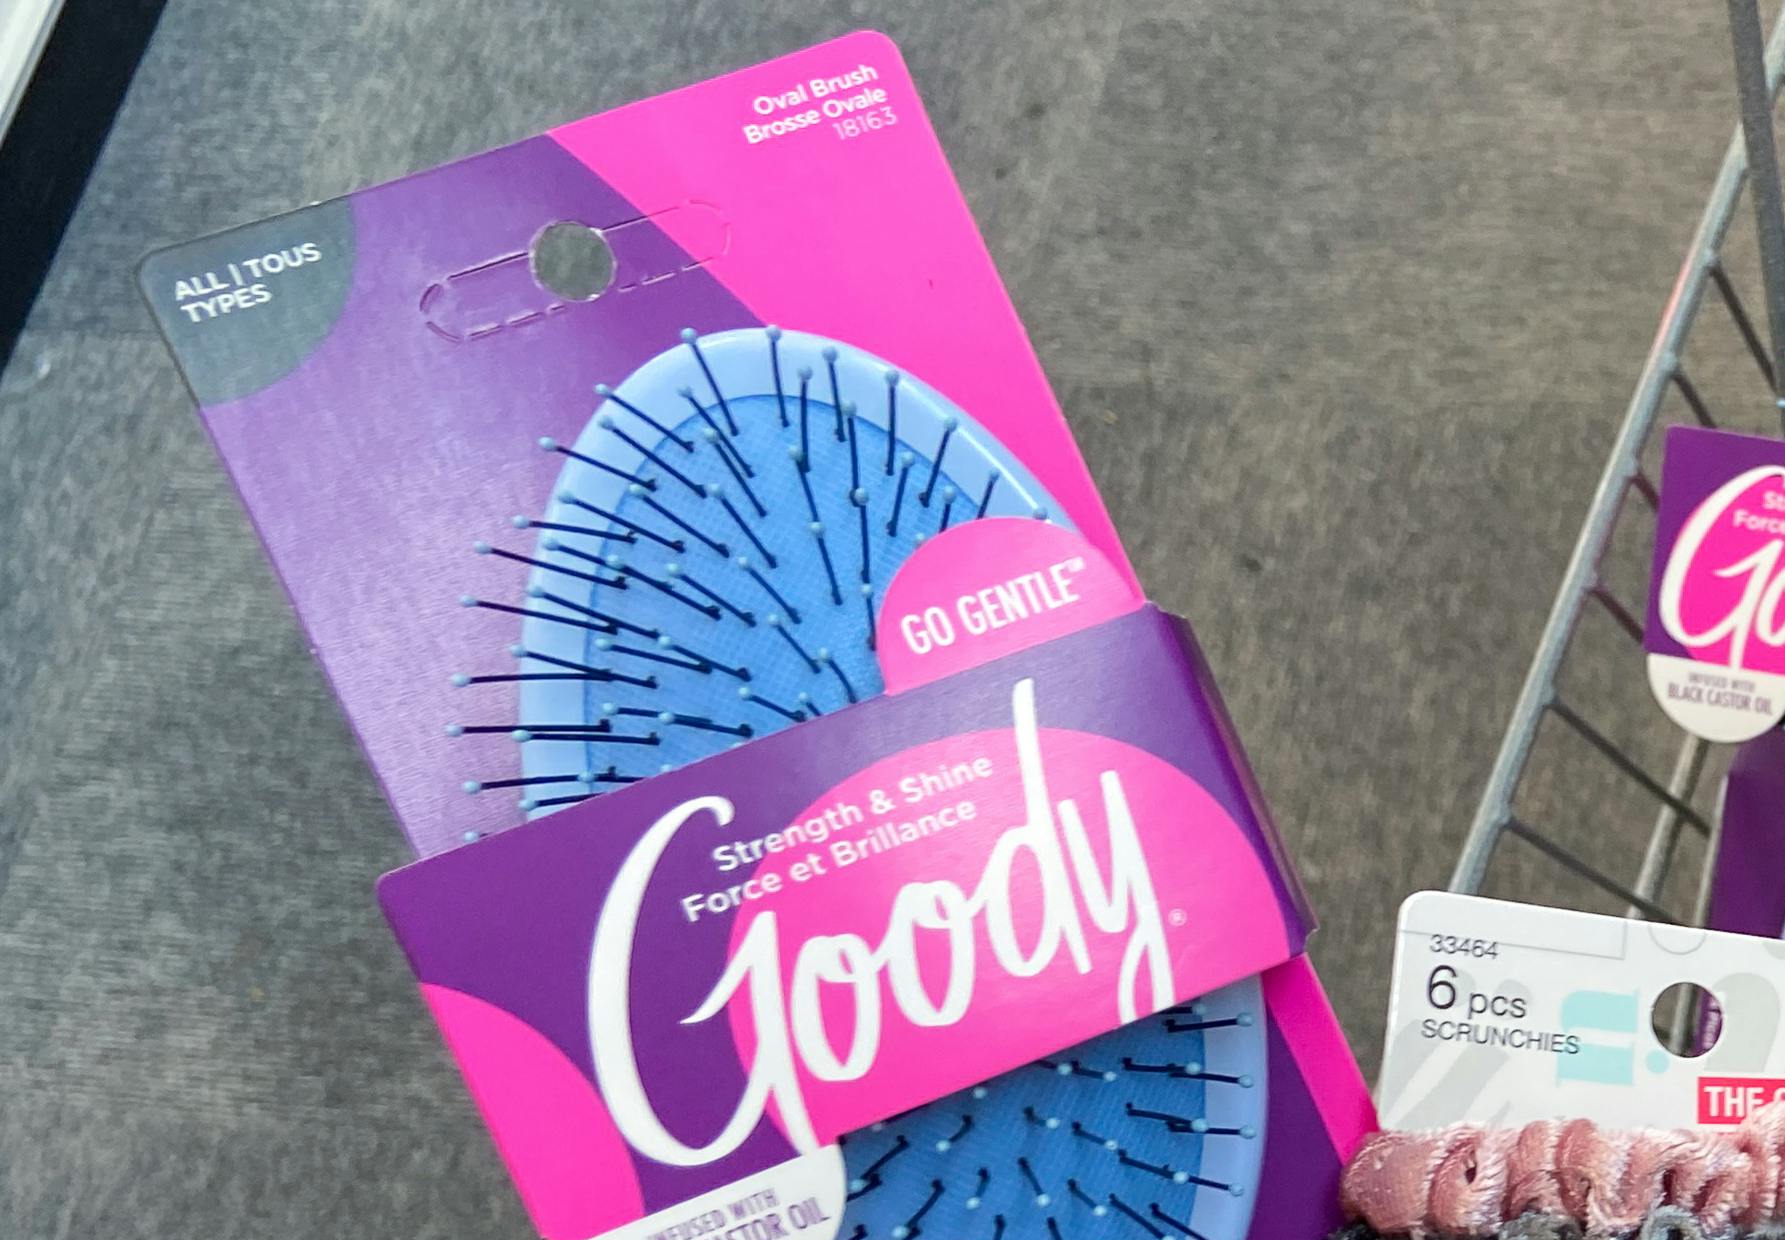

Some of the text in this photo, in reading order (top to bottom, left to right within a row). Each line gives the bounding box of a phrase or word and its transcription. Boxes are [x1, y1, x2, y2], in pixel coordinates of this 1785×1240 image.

[742, 88, 888, 144] Brosse Ovale
[753, 64, 879, 115] Oval Brush
[832, 106, 897, 140] 18163
[175, 271, 230, 301] ALL
[242, 242, 322, 278] TOUS
[180, 283, 272, 323] TYPES
[900, 571, 1080, 655] GO GENTLE
[712, 756, 994, 871] Strength & Shine
[680, 800, 977, 923] Force et Brillance
[588, 678, 1175, 1166] Goody
[1429, 933, 1500, 959] 33464
[1428, 965, 1527, 1020] 6 pcs
[1421, 1018, 1580, 1054] SCRUNCHIES
[727, 1187, 780, 1221] WITH
[787, 1196, 832, 1230] OIL
